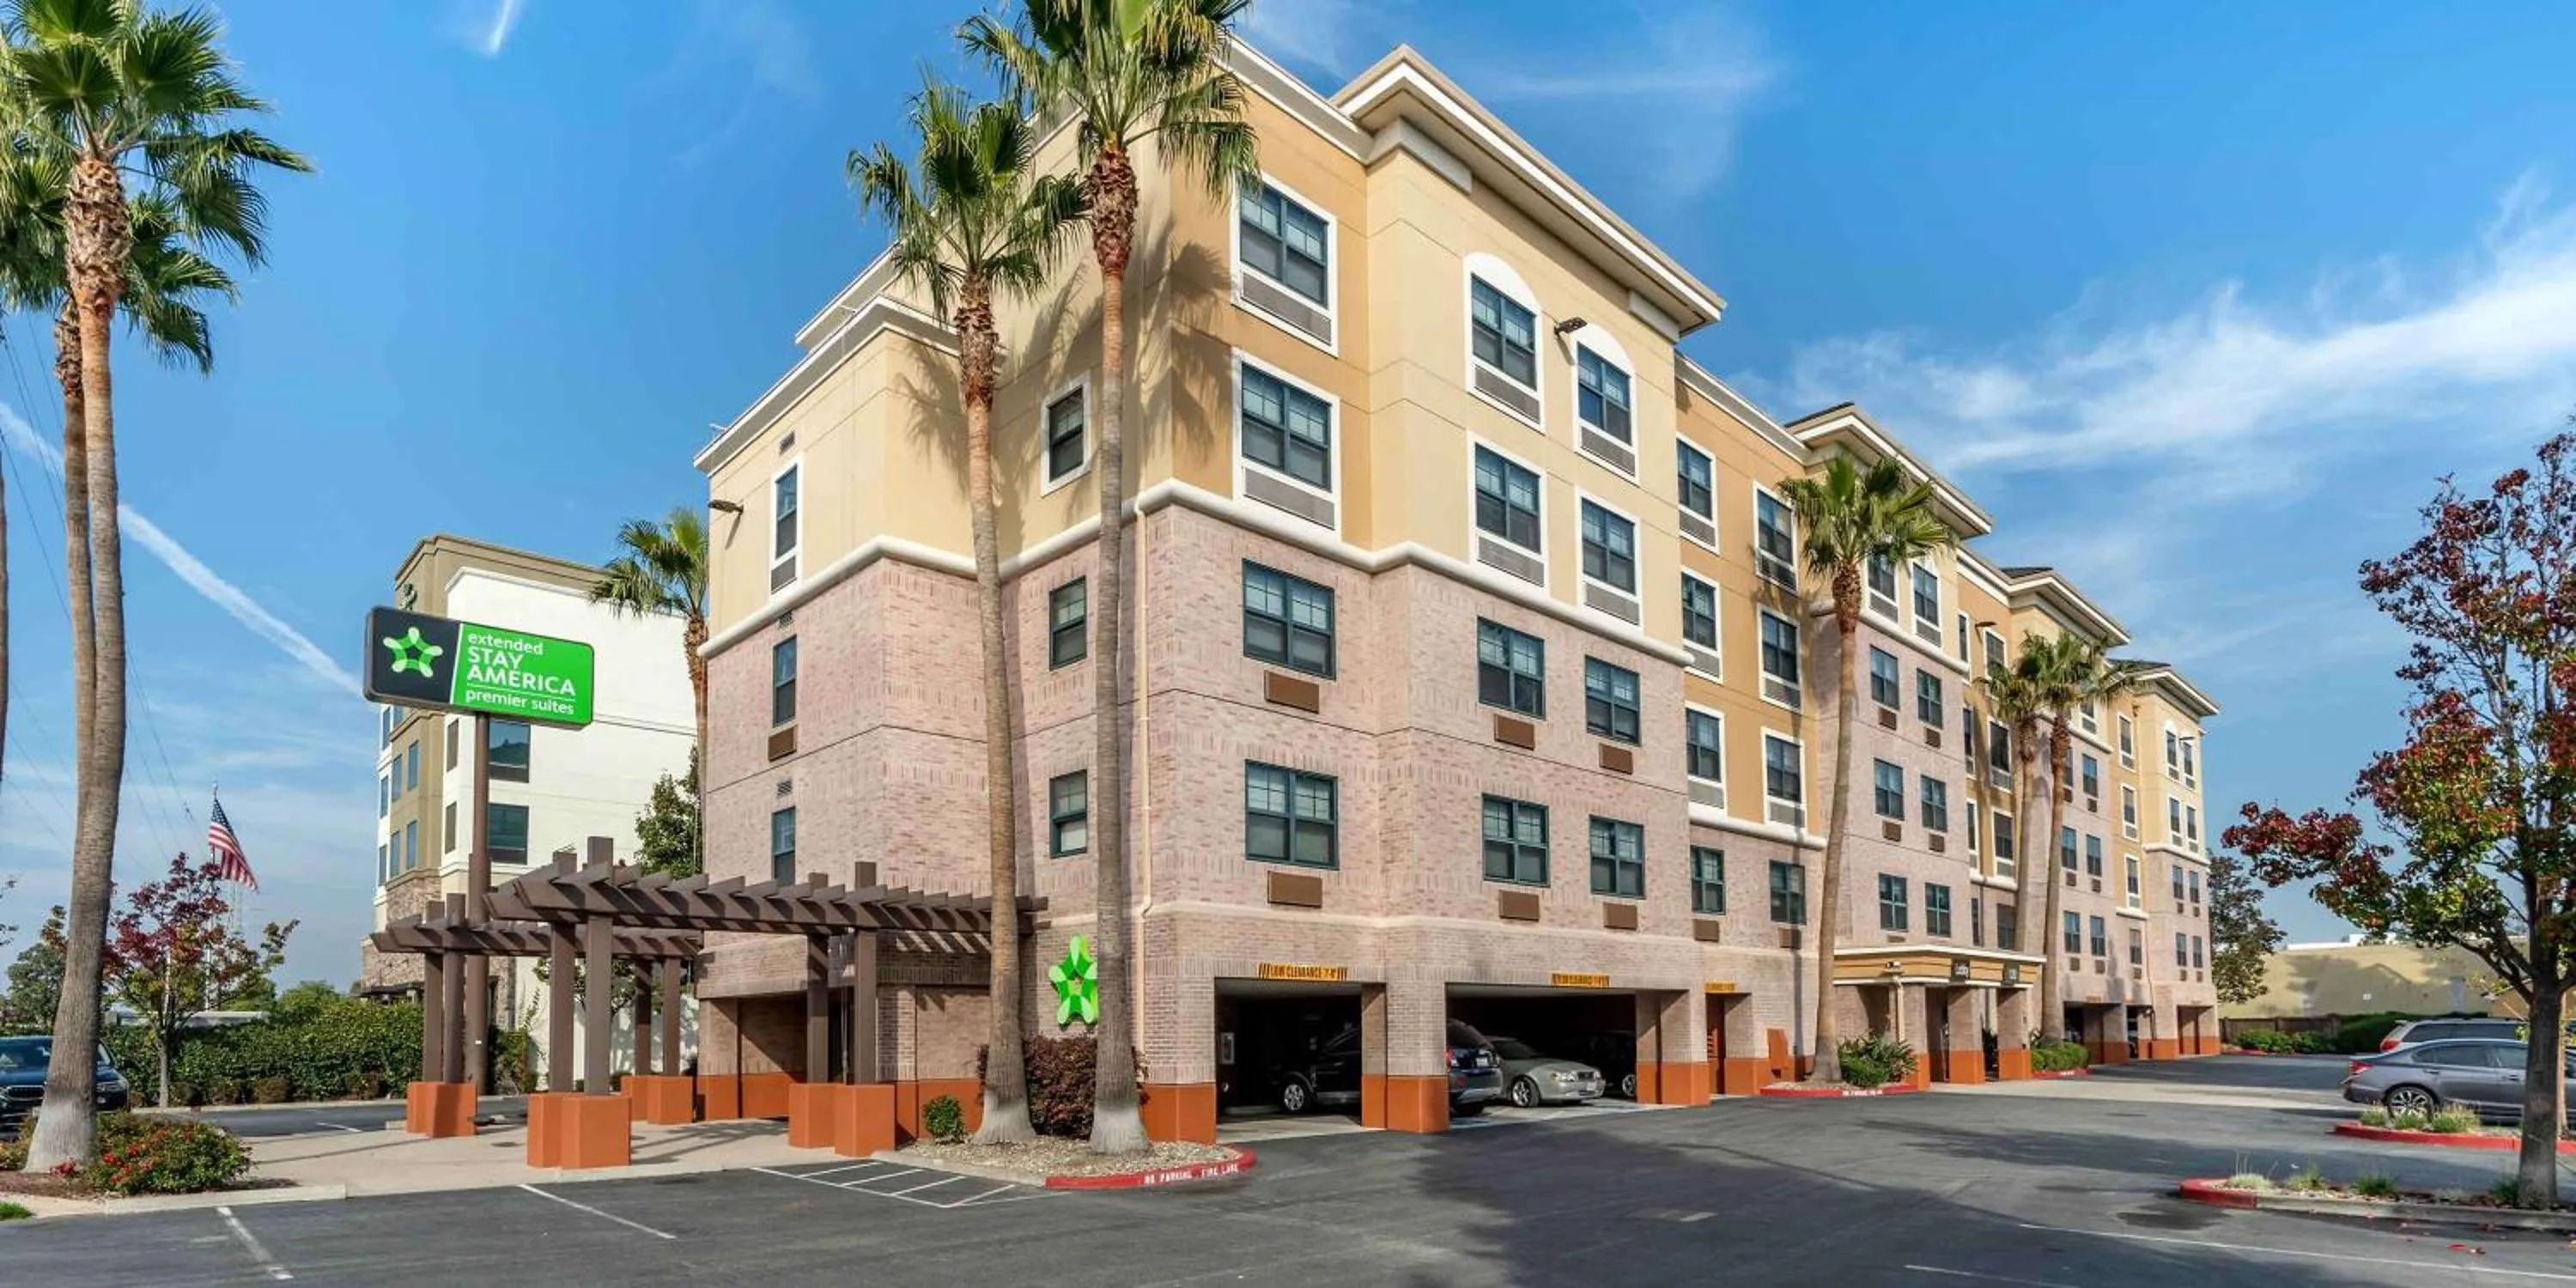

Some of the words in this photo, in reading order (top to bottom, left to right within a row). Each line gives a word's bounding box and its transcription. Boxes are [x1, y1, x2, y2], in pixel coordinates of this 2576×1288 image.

[467, 634, 544, 655] extended
[467, 646, 524, 669] STAY
[466, 664, 576, 696] AMERICA
[466, 690, 527, 708] premier
[531, 699, 574, 715] suites
[1144, 1174, 1155, 1184] NO
[1159, 1170, 1193, 1182] PARKING
[1221, 1163, 1238, 1176] LANE
